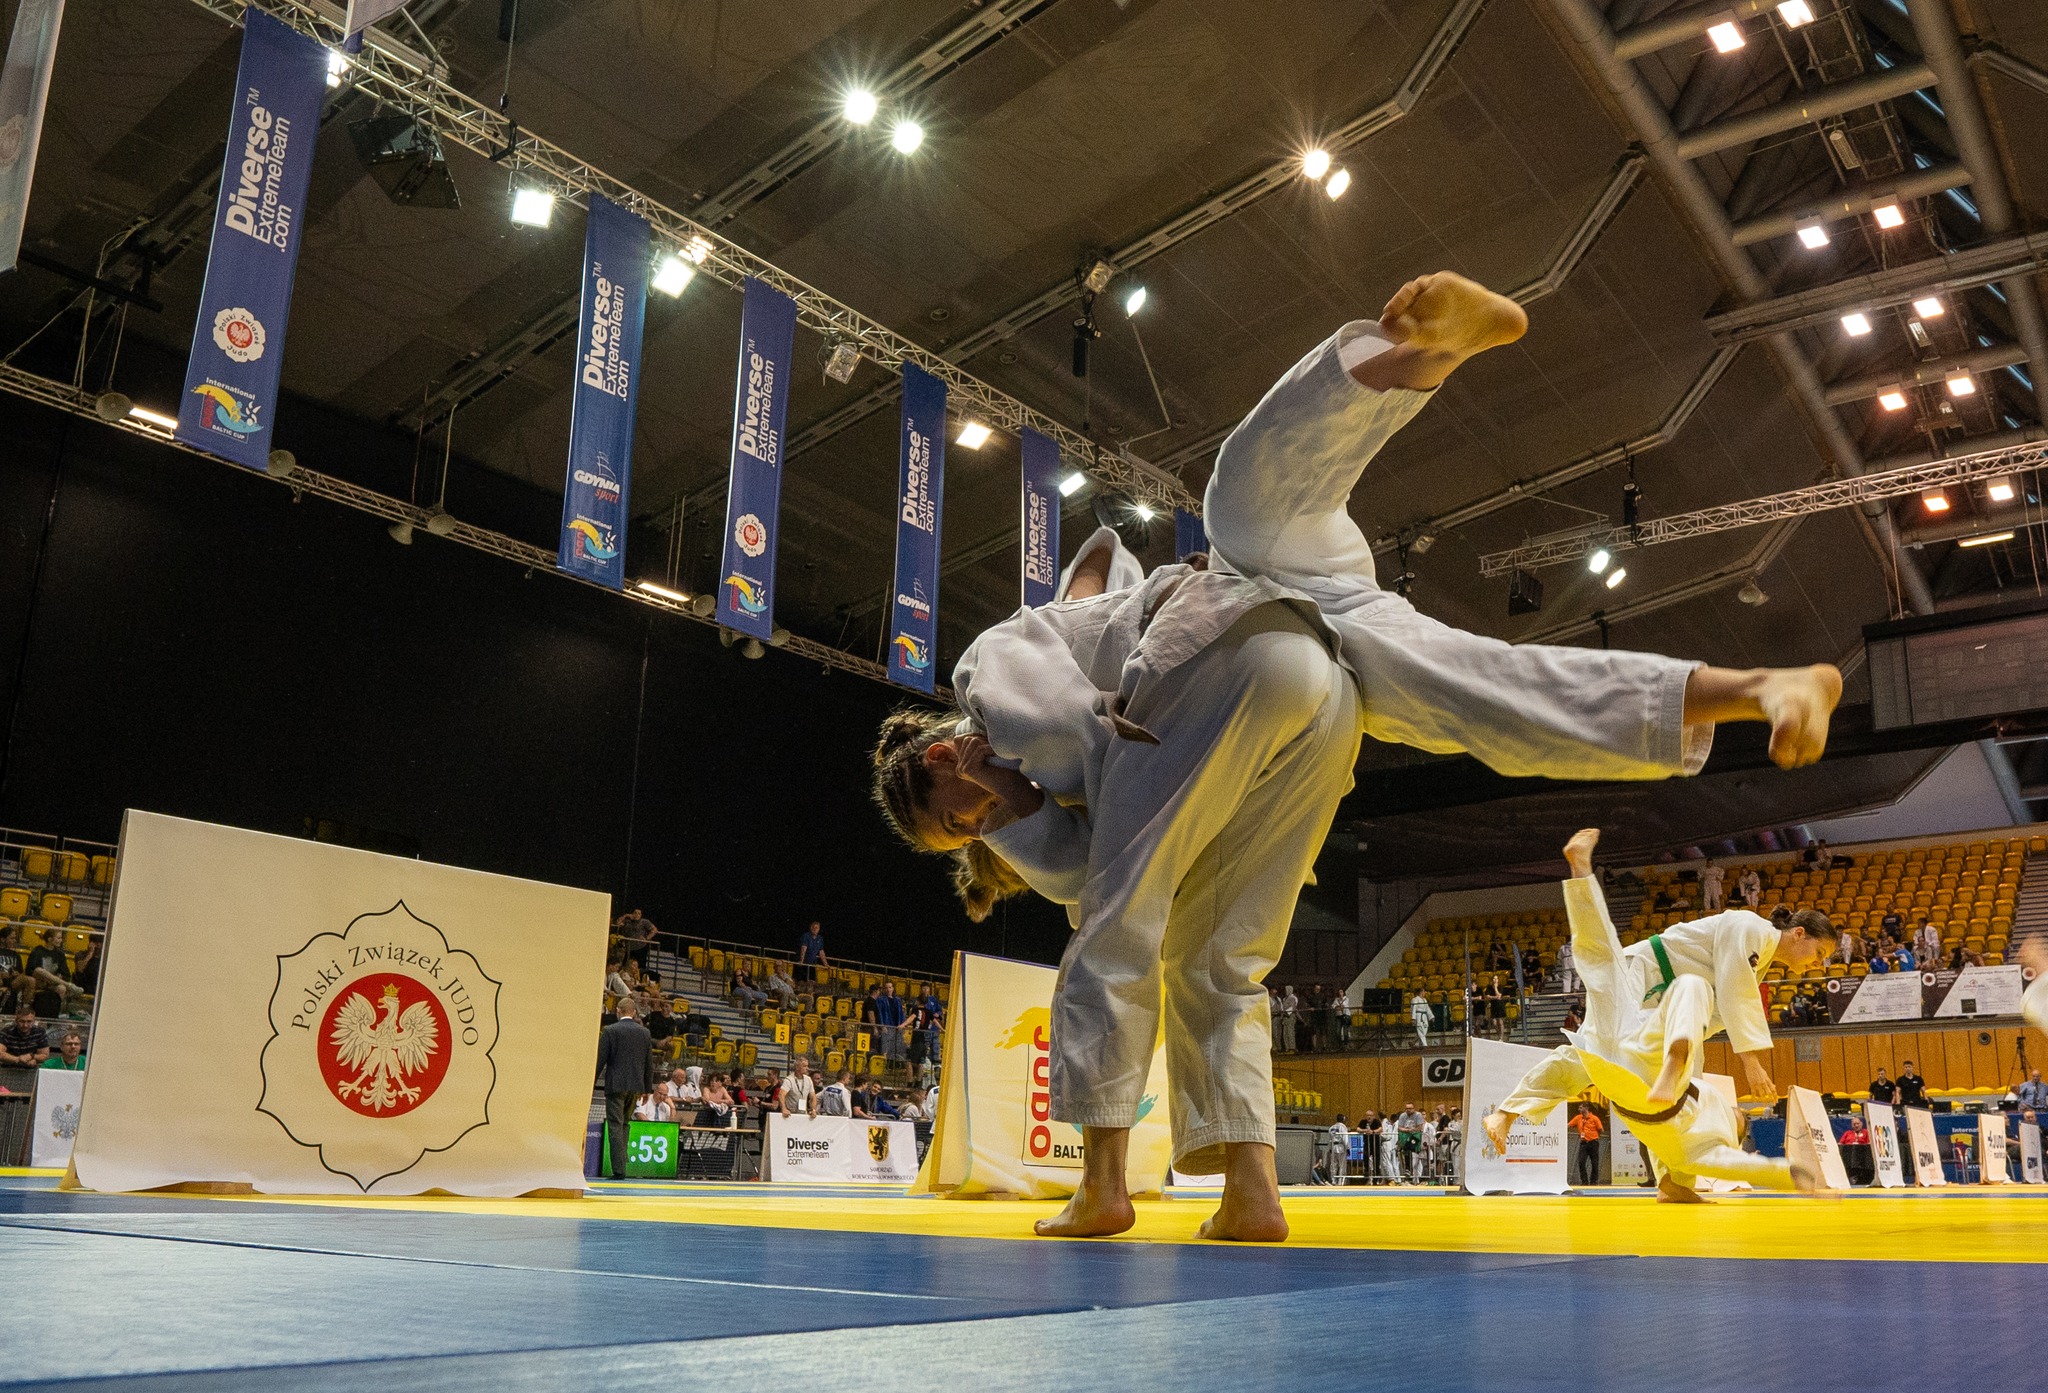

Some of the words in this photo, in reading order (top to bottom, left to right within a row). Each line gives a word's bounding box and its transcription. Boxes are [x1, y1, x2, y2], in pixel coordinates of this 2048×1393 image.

[225, 106, 272, 236] Diverse
[253, 116, 290, 244] ExtremeTeam
[274, 206, 292, 252] .com
[582, 278, 612, 390] Diverse
[602, 285, 625, 396] ExtremeTeam
[206, 377, 256, 400] International
[617, 360, 630, 402] .com
[739, 353, 764, 456] Diverse
[755, 360, 774, 462] ExtremeTeam
[766, 430, 778, 468] .com
[574, 470, 620, 494] GDYNIA
[902, 431, 921, 526] Diverse
[916, 436, 930, 530] ExtremeTeam
[926, 500, 934, 535] .com
[1026, 493, 1040, 583] Diverse
[898, 594, 930, 614] GDYNIA
[291, 960, 344, 1031] Polski
[348, 942, 444, 980] Związek
[439, 977, 479, 1046] JUDO
[780, 1032, 785, 1041] 5
[861, 1040, 866, 1049] 6
[1029, 1025, 1051, 1158] JUDO
[1427, 1059, 1465, 1083] GD
[787, 1138, 829, 1150] Diverse
[787, 1150, 829, 1158] ExtremeTeam
[1053, 1145, 1084, 1159] BALT
[1533, 1132, 1559, 1149] Turystyki
